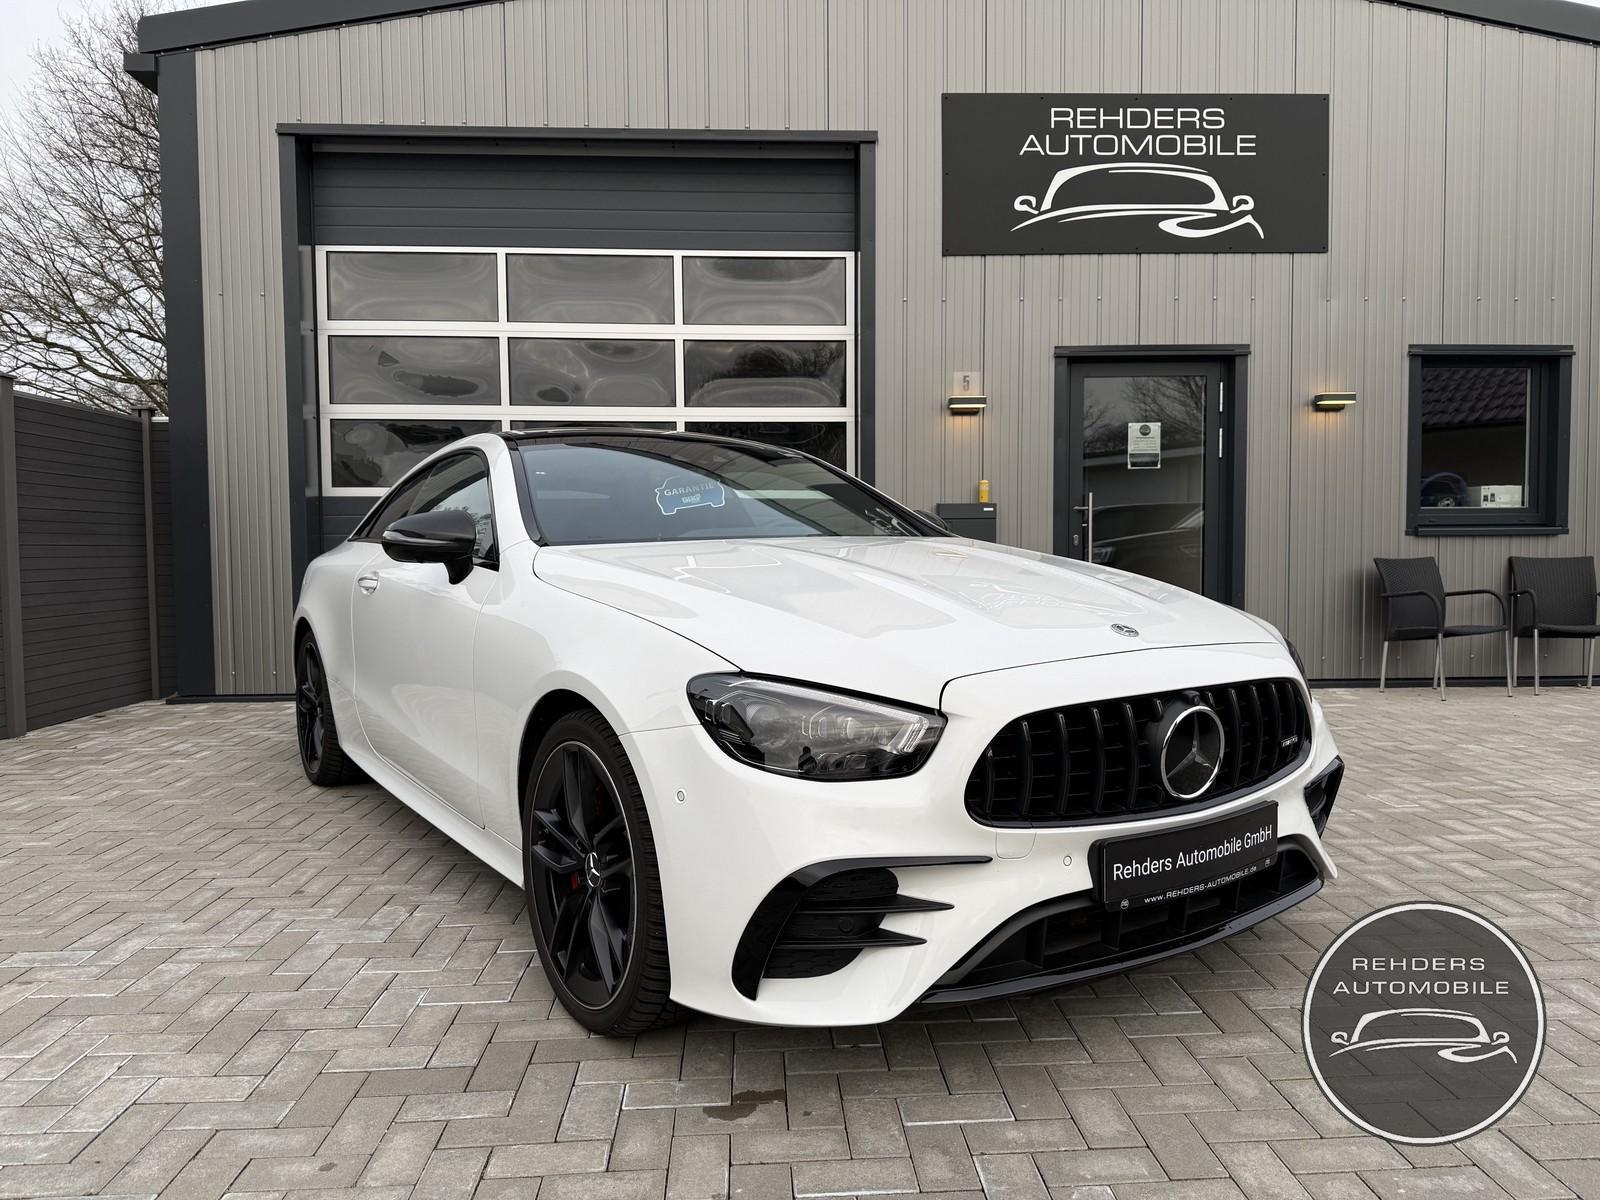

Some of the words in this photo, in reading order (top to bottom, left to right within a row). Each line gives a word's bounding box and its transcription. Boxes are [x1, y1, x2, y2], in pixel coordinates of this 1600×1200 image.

[1050, 107, 1225, 129] REHDERS
[1019, 134, 1257, 156] AUTOMOBILE
[963, 375, 970, 391] 5
[1113, 857, 1173, 881] Rehders
[1176, 836, 1242, 869] Automobile
[1243, 824, 1273, 849] GmbH
